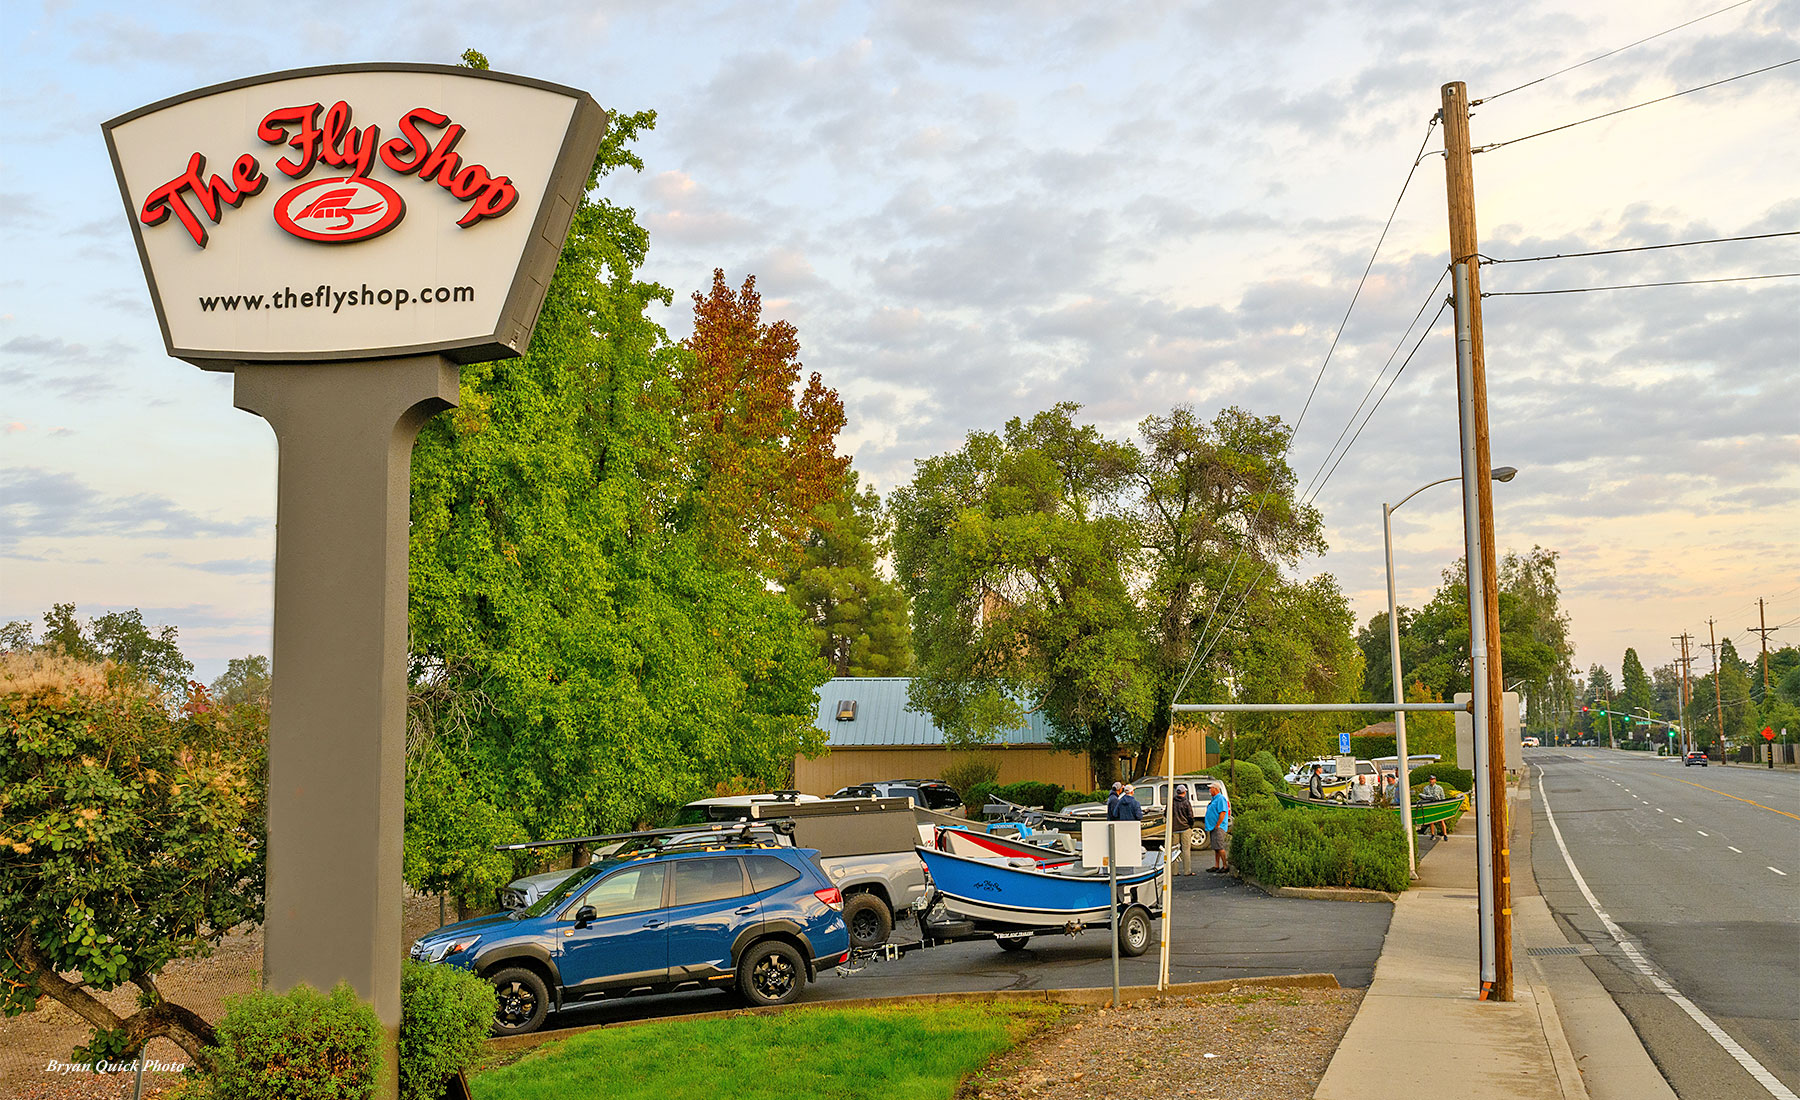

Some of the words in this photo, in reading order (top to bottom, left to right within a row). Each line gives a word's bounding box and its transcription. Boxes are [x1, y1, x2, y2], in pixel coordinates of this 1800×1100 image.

[140, 152, 268, 249] The
[257, 100, 381, 181] Fly
[379, 107, 519, 229] Shop
[198, 283, 475, 314] www.theflyshop.com
